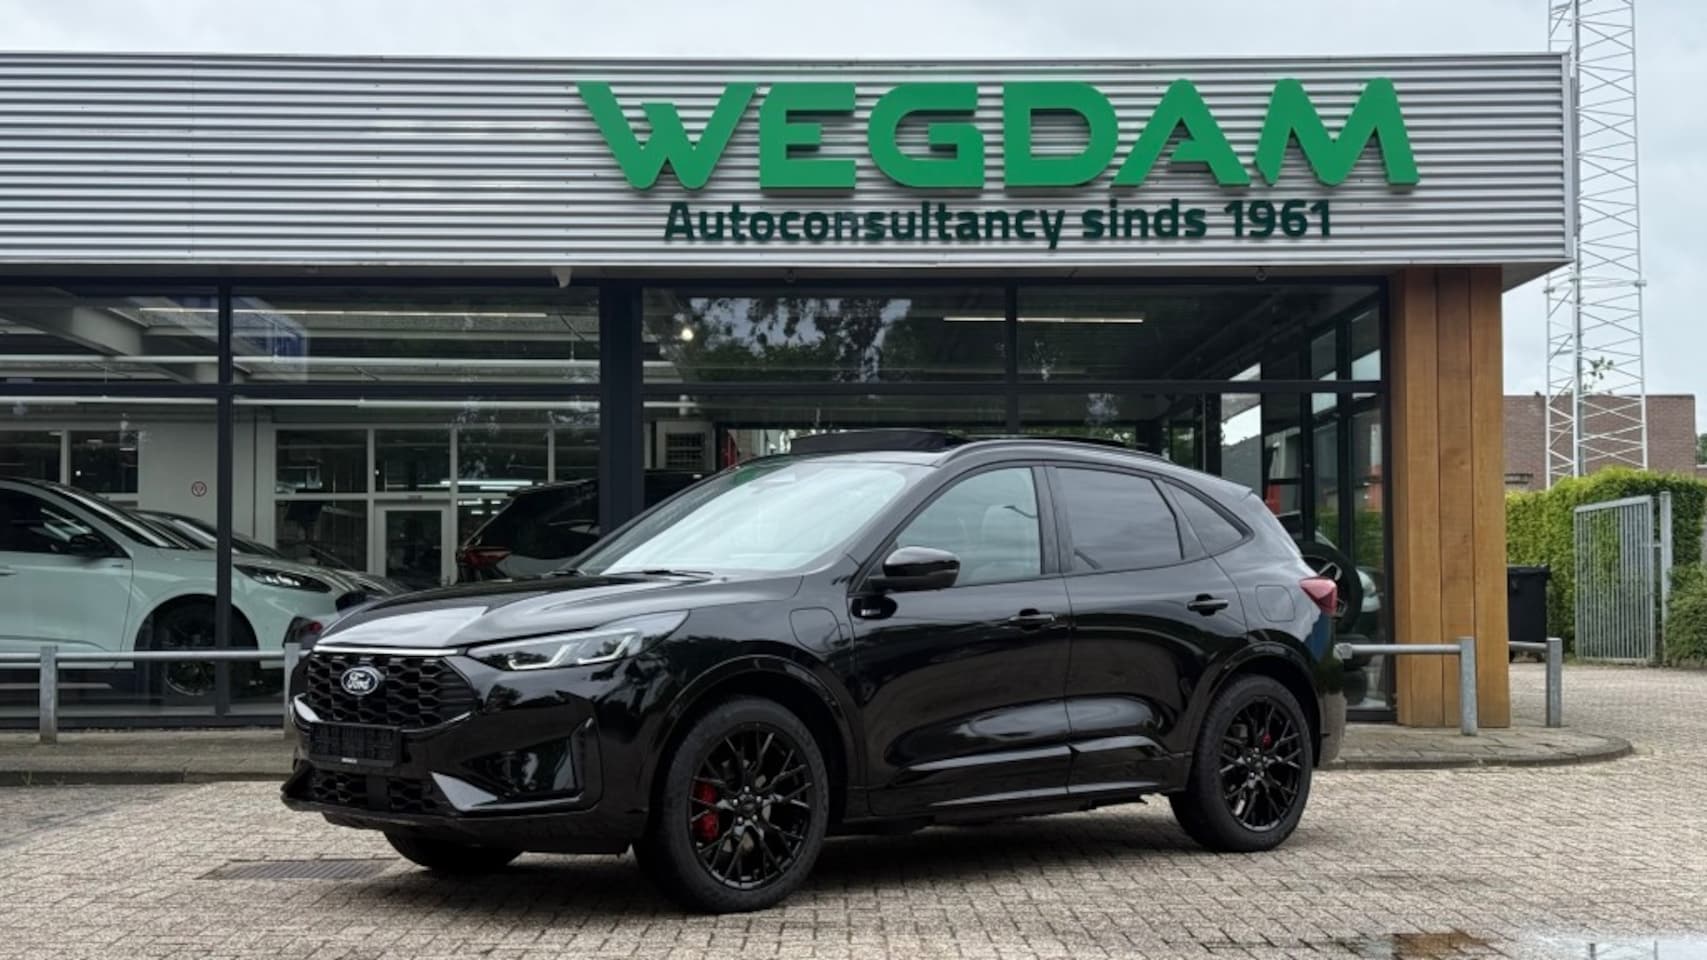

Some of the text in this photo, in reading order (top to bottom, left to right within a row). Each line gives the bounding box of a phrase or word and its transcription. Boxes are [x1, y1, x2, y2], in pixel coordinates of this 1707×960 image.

[575, 78, 1420, 189] WEGDAM
[664, 198, 1331, 249] Autoconsultancy sinds 1961
[345, 670, 373, 691] Ford
